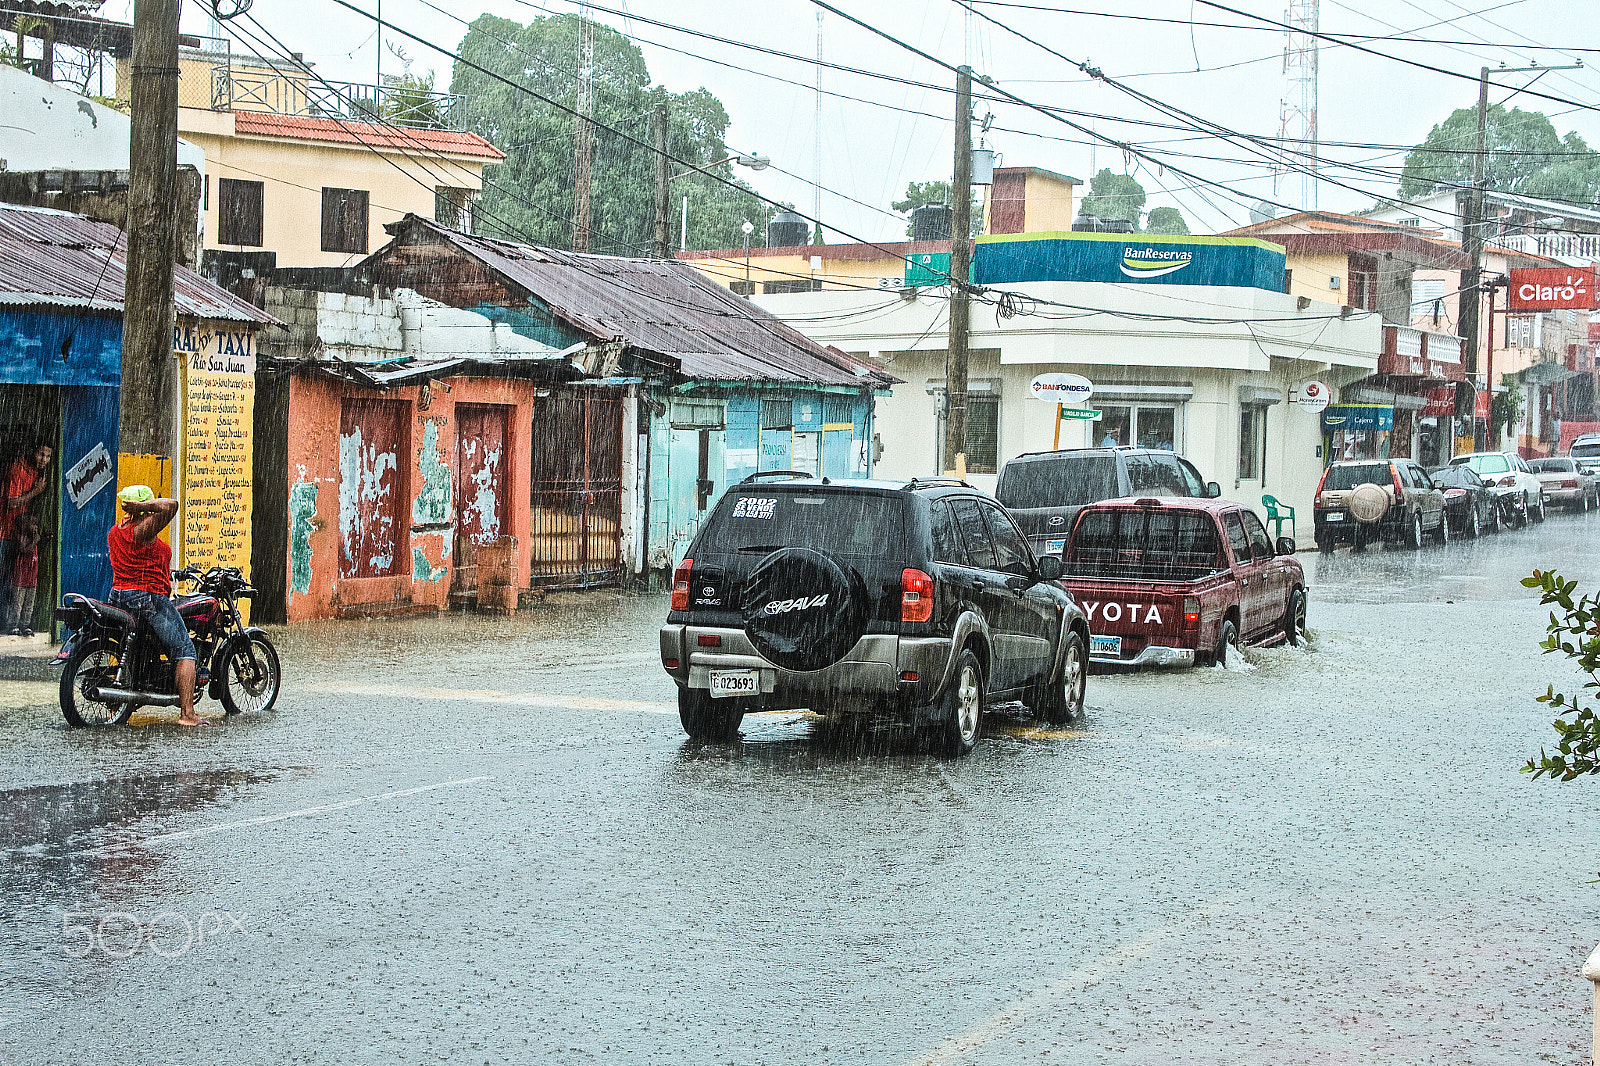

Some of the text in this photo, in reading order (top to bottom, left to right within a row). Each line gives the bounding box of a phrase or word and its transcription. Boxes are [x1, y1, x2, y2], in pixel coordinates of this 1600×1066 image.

[1124, 247, 1192, 260] BanReservas
[1519, 284, 1575, 301] Claro
[215, 330, 252, 356] TAXI
[208, 355, 223, 372] San
[225, 357, 246, 374] Juan
[1042, 383, 1090, 393] BANFONDESA
[735, 503, 776, 512] SE VENDE
[738, 497, 778, 505] 2002
[732, 510, 746, 518] 809
[777, 593, 830, 614] RAV4
[1082, 601, 1163, 624] YOTA
